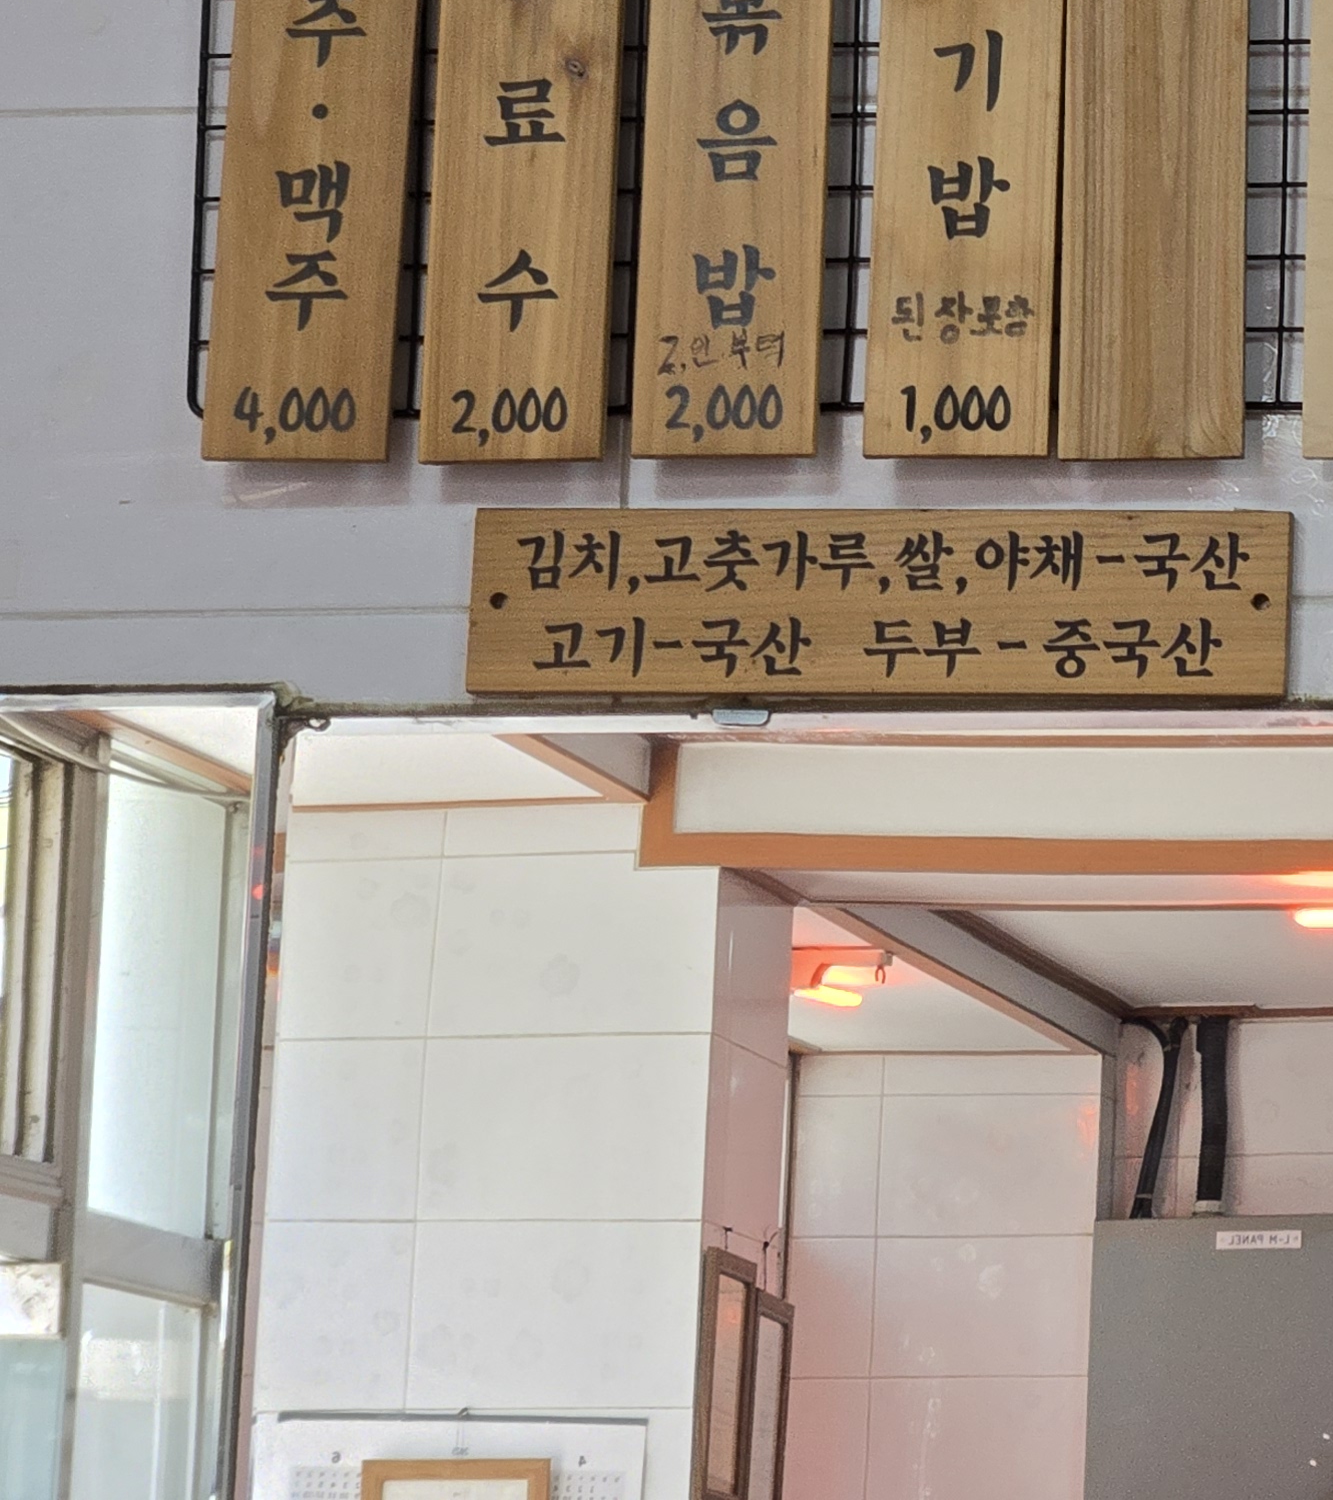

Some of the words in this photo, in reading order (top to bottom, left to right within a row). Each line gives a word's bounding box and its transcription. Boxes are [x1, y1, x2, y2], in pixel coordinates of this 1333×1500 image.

[233, 386, 357, 446] 4,000
[450, 386, 568, 448] 2,000
[664, 383, 783, 444] 2,000
[900, 384, 1012, 444] 1,000
